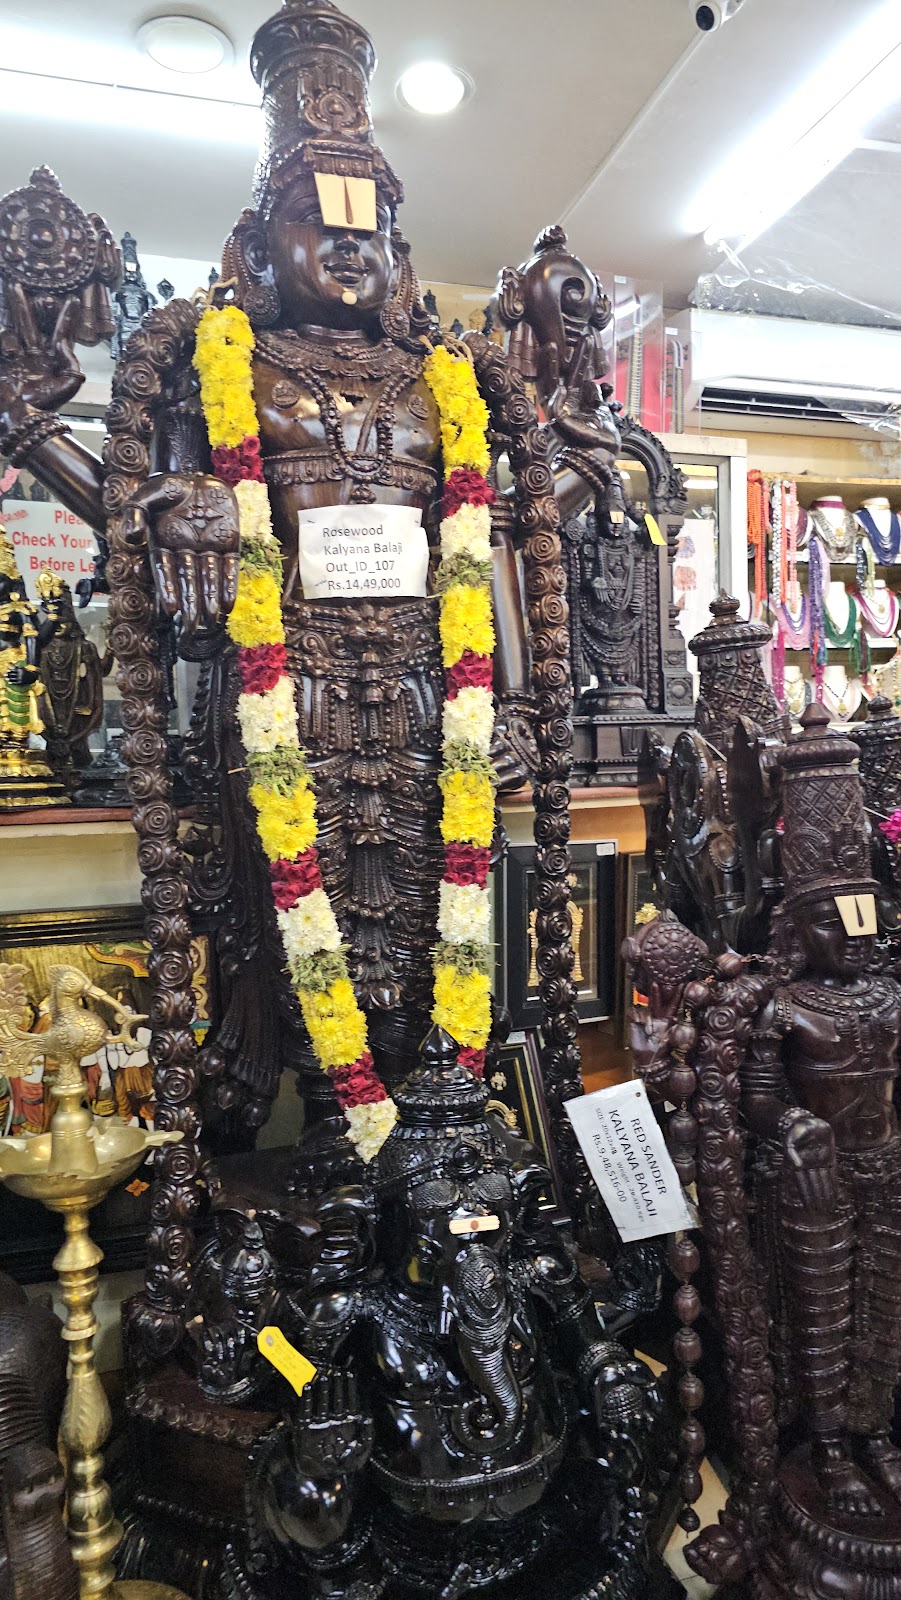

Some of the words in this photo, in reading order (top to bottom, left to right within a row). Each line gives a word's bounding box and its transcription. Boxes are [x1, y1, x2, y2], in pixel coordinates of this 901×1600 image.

[12, 531, 56, 547] Check
[60, 533, 92, 548] Your
[322, 525, 383, 538] Rosewood
[324, 544, 370, 556] Kalyana
[374, 542, 402, 554] Balaji
[30, 556, 75, 572] Before
[326, 560, 395, 574] Out_ID_107
[328, 578, 400, 590] Rs.14,49,000
[608, 1109, 640, 1171] KALYANA
[634, 1172, 658, 1217] BALAJI
[630, 1118, 647, 1144] RED
[641, 1145, 667, 1195] SANDER
[592, 1133, 628, 1202] Rs.9,48,516-00
